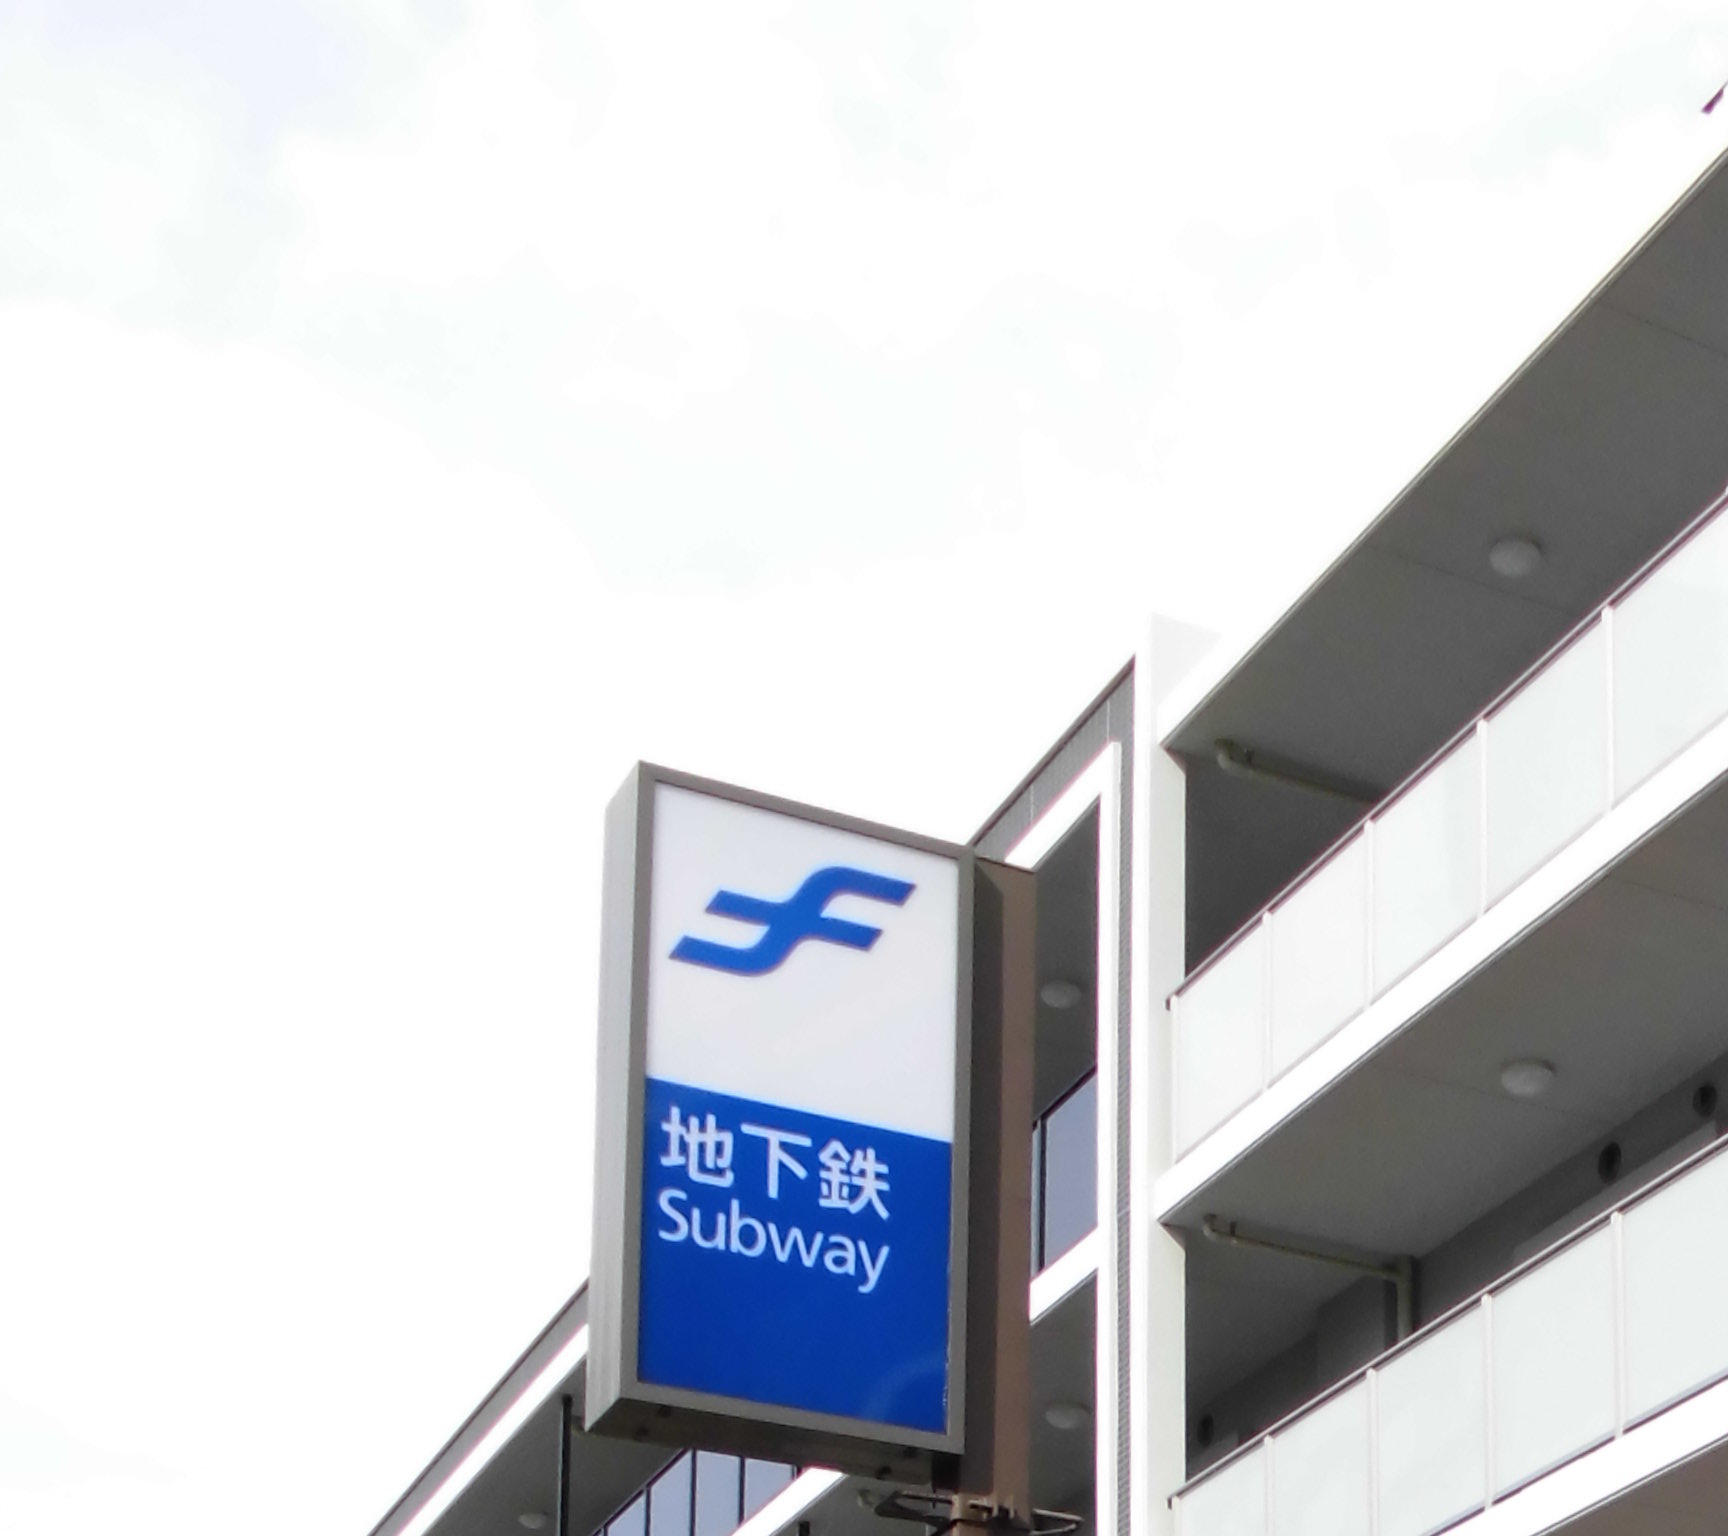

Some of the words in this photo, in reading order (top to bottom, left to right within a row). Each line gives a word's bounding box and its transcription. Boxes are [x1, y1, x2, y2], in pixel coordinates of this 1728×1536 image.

[659, 1105, 891, 1221] 地下鉄
[657, 1188, 890, 1295] Subway
